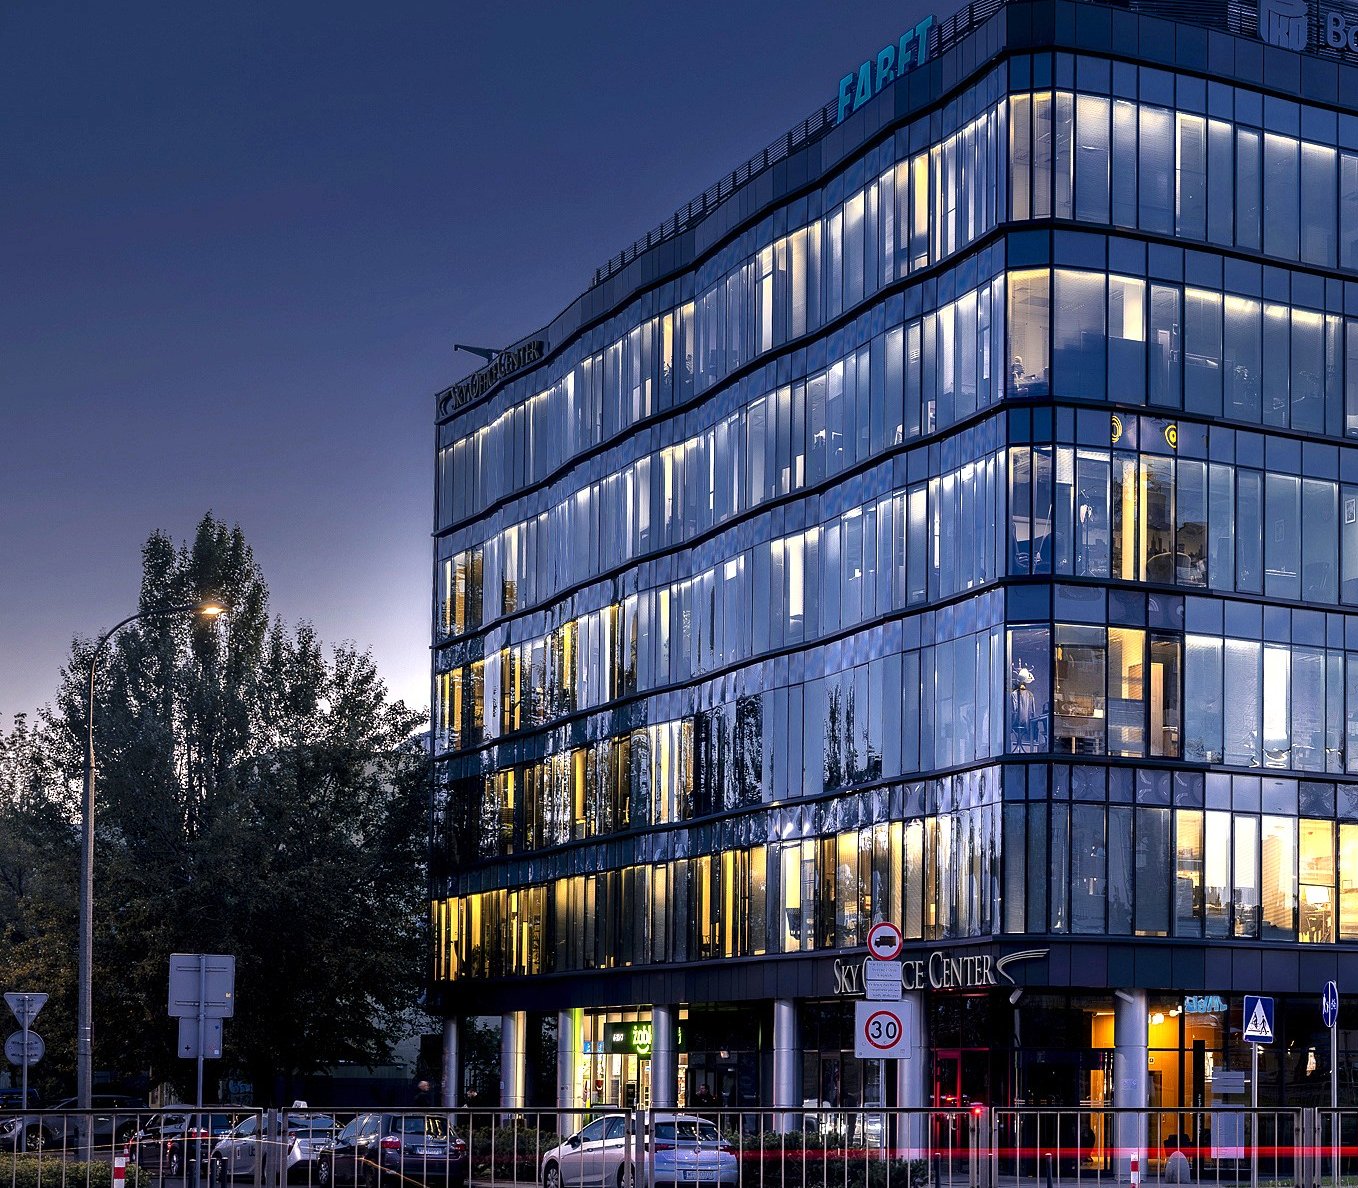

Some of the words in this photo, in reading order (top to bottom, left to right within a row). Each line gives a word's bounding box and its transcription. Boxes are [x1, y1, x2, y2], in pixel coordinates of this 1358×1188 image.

[833, 958, 860, 995] SKY
[928, 951, 999, 990] CENTER
[871, 1020, 897, 1040] 30
